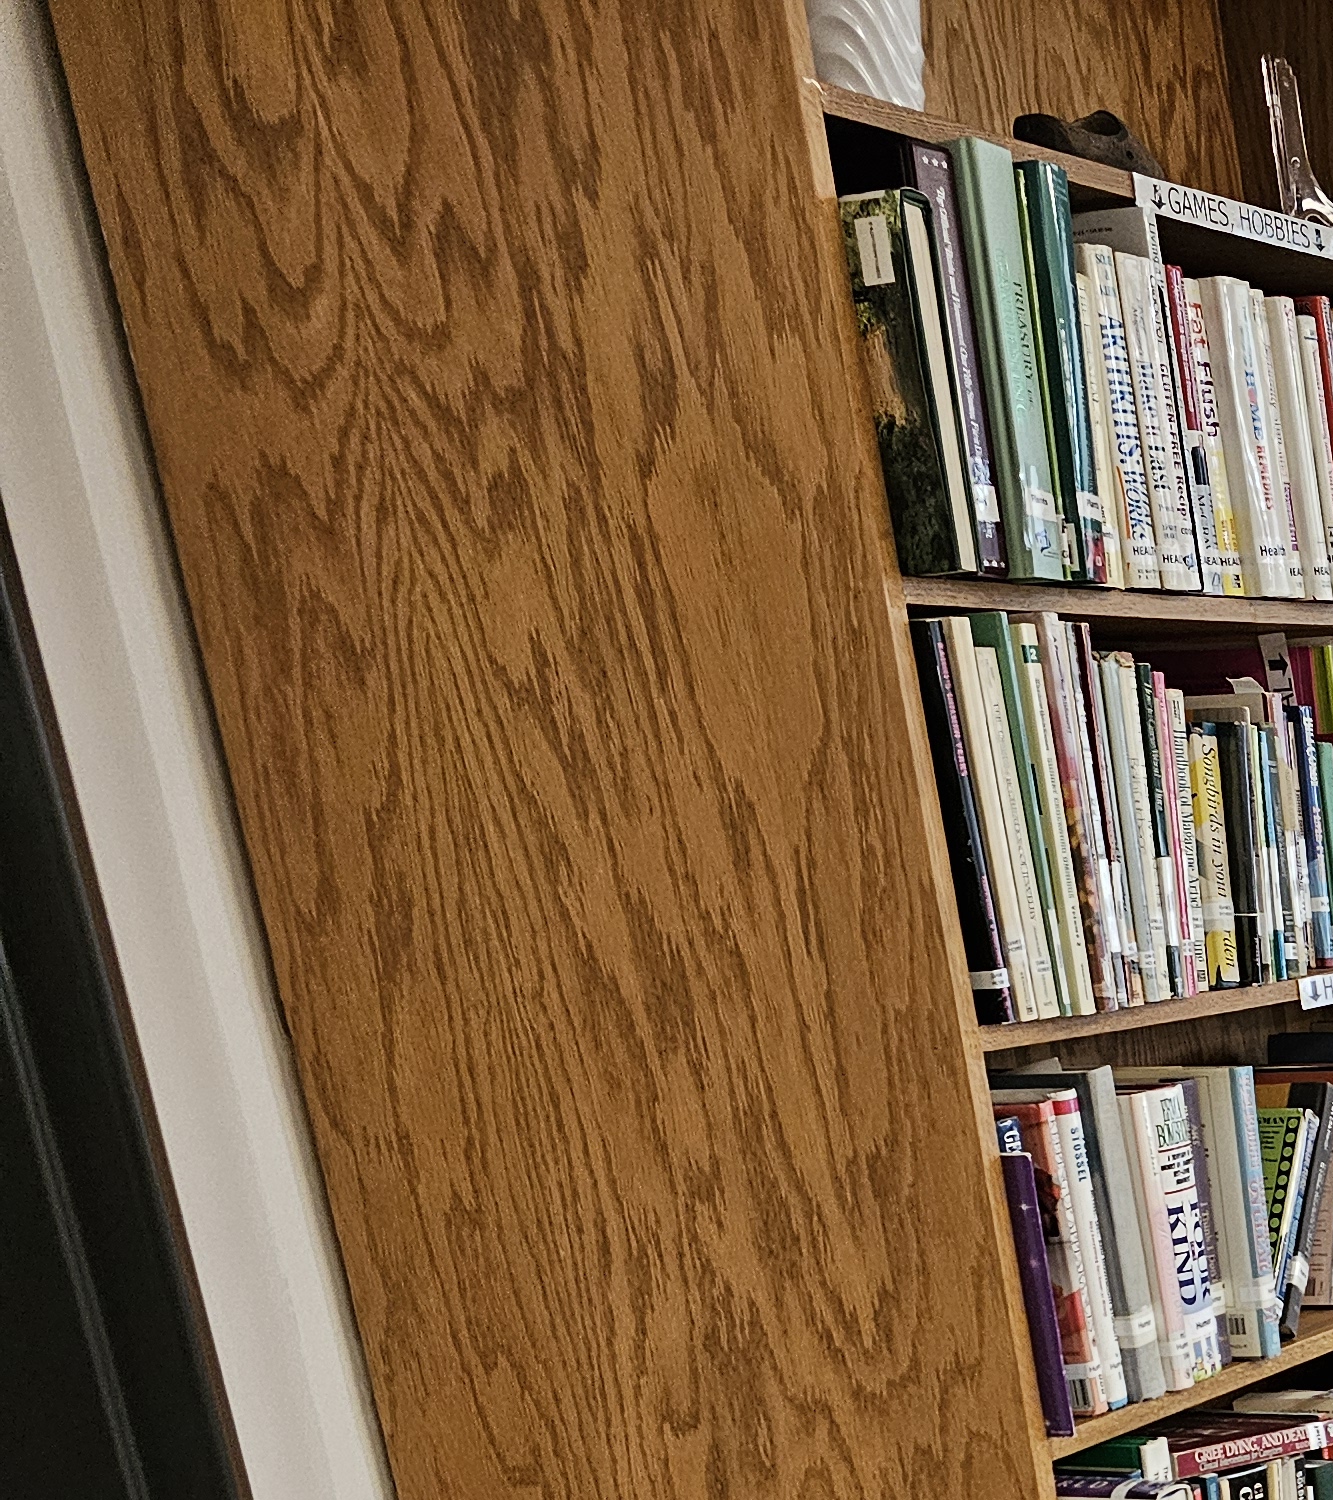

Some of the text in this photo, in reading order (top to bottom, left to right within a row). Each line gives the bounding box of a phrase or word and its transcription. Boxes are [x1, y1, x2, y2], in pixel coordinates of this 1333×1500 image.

[1168, 187, 1311, 249] GAMES, HOBBIES
[1190, 303, 1219, 437] Fat Flush
[1160, 363, 1187, 521] GLUTEN-FREE Recip
[1256, 445, 1275, 511] REMEDIES
[1174, 729, 1190, 793] Handbook
[1181, 810, 1197, 872] Magazine
[1202, 743, 1223, 833] Songbirds
[1213, 839, 1225, 854] in
[1223, 930, 1237, 968] rden
[1070, 1126, 1088, 1182] STOSSEL
[1166, 1202, 1198, 1306] KIND
[1226, 1438, 1261, 1457] DYING,
[1262, 1433, 1284, 1450] AND
